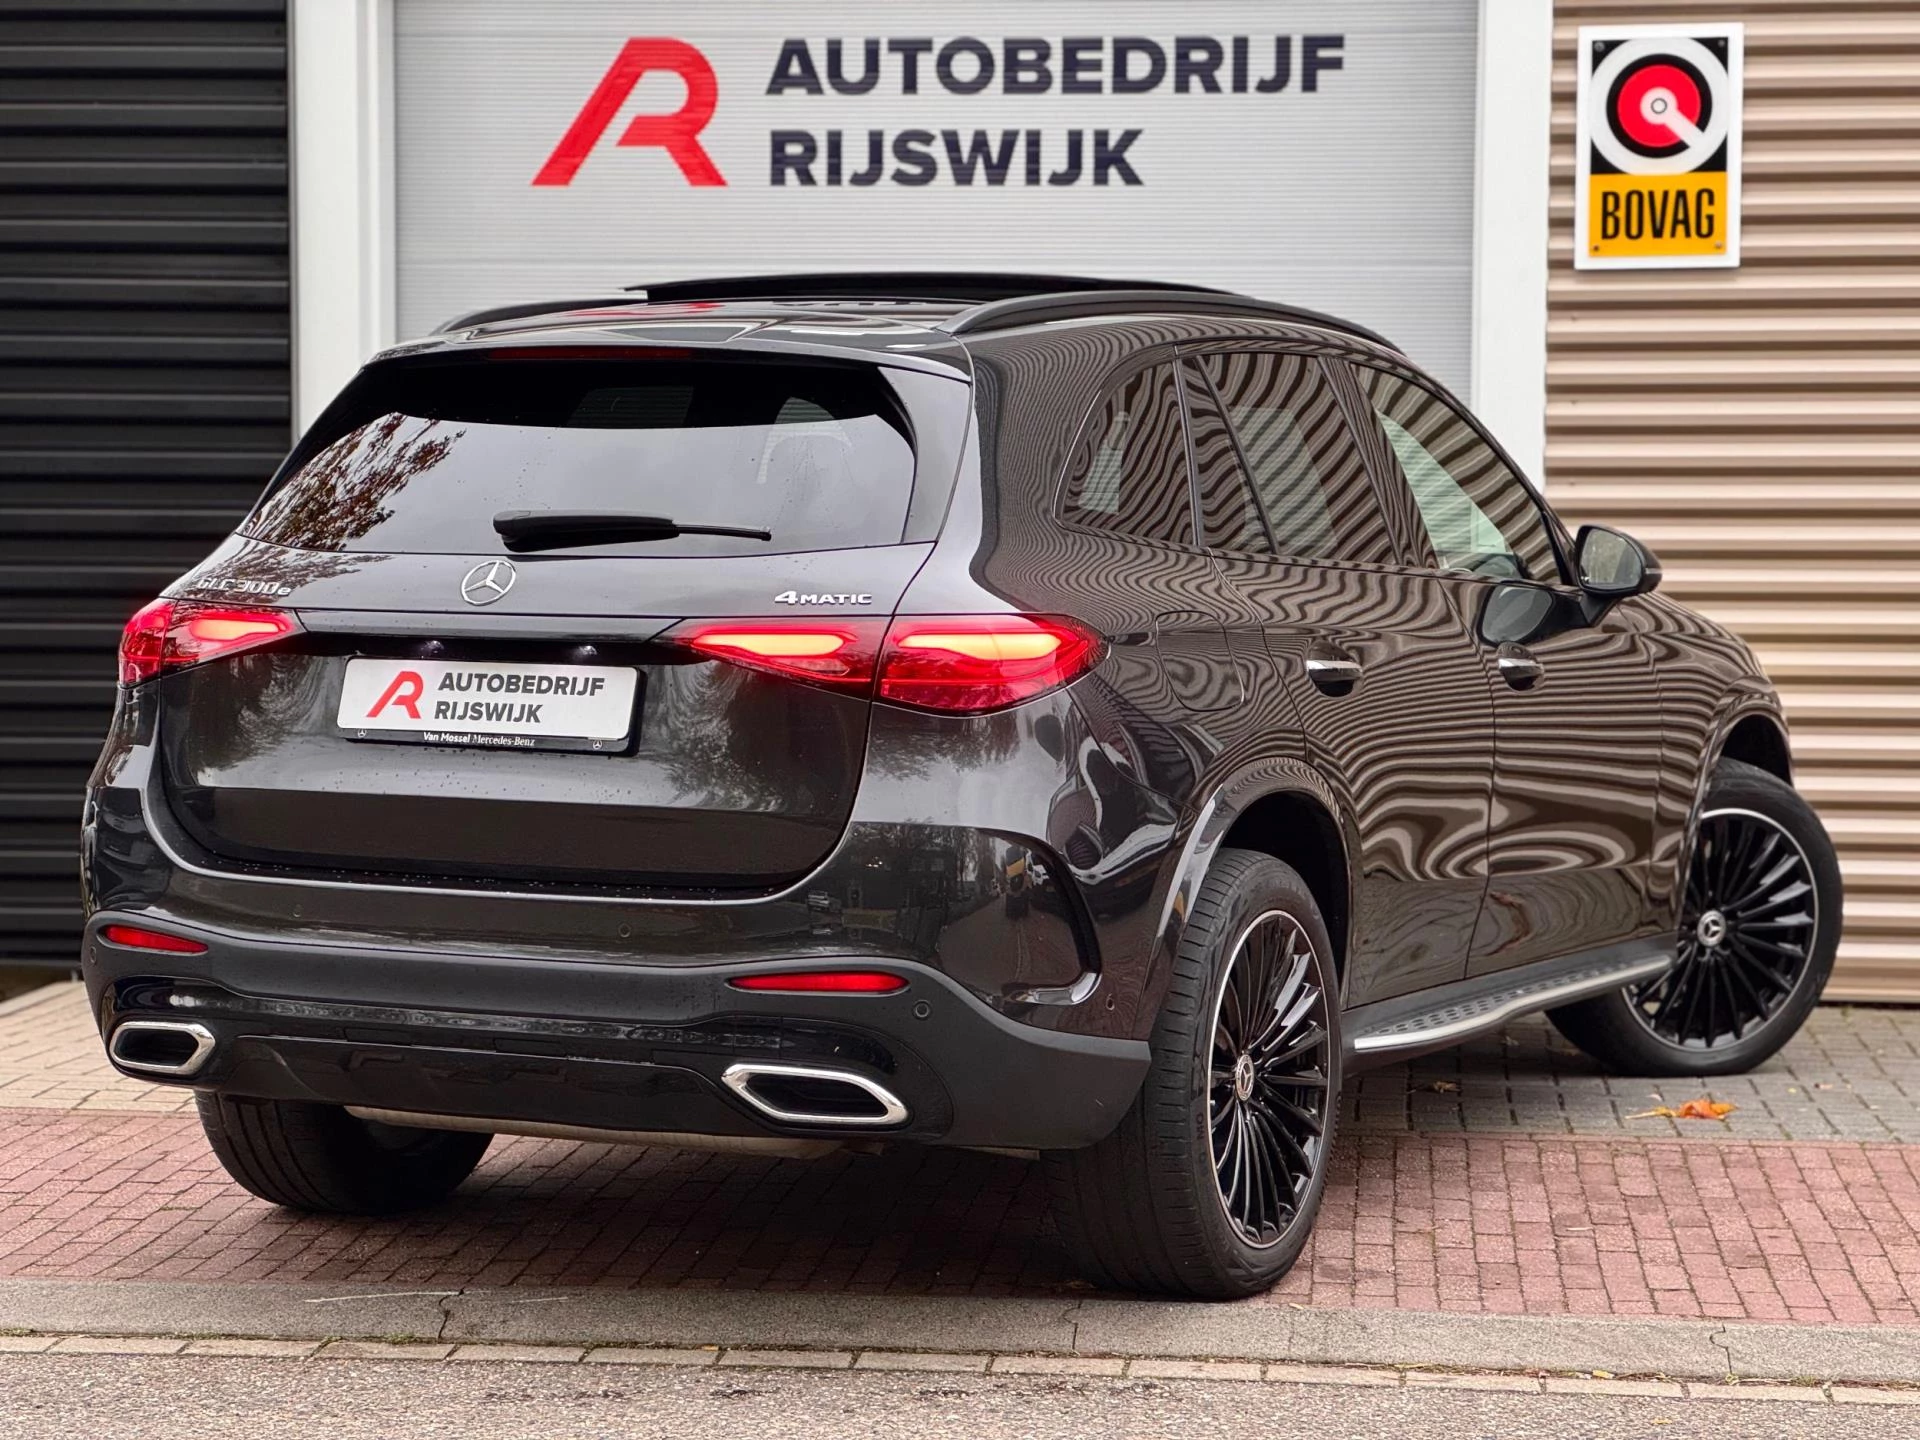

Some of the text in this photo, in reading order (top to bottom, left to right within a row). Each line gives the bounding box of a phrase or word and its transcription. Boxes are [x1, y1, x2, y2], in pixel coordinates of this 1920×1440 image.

[765, 34, 1345, 95] AUTOBEDRIJF
[770, 129, 1143, 187] RIJSWIJK
[1601, 188, 1715, 240] BOVAG
[774, 590, 872, 605] 4MATIC
[438, 672, 605, 697] AUTOBEDRIJF
[434, 701, 543, 723] RIJSWIJK
[423, 731, 536, 747] Van Mossel Mercedes-Benz
